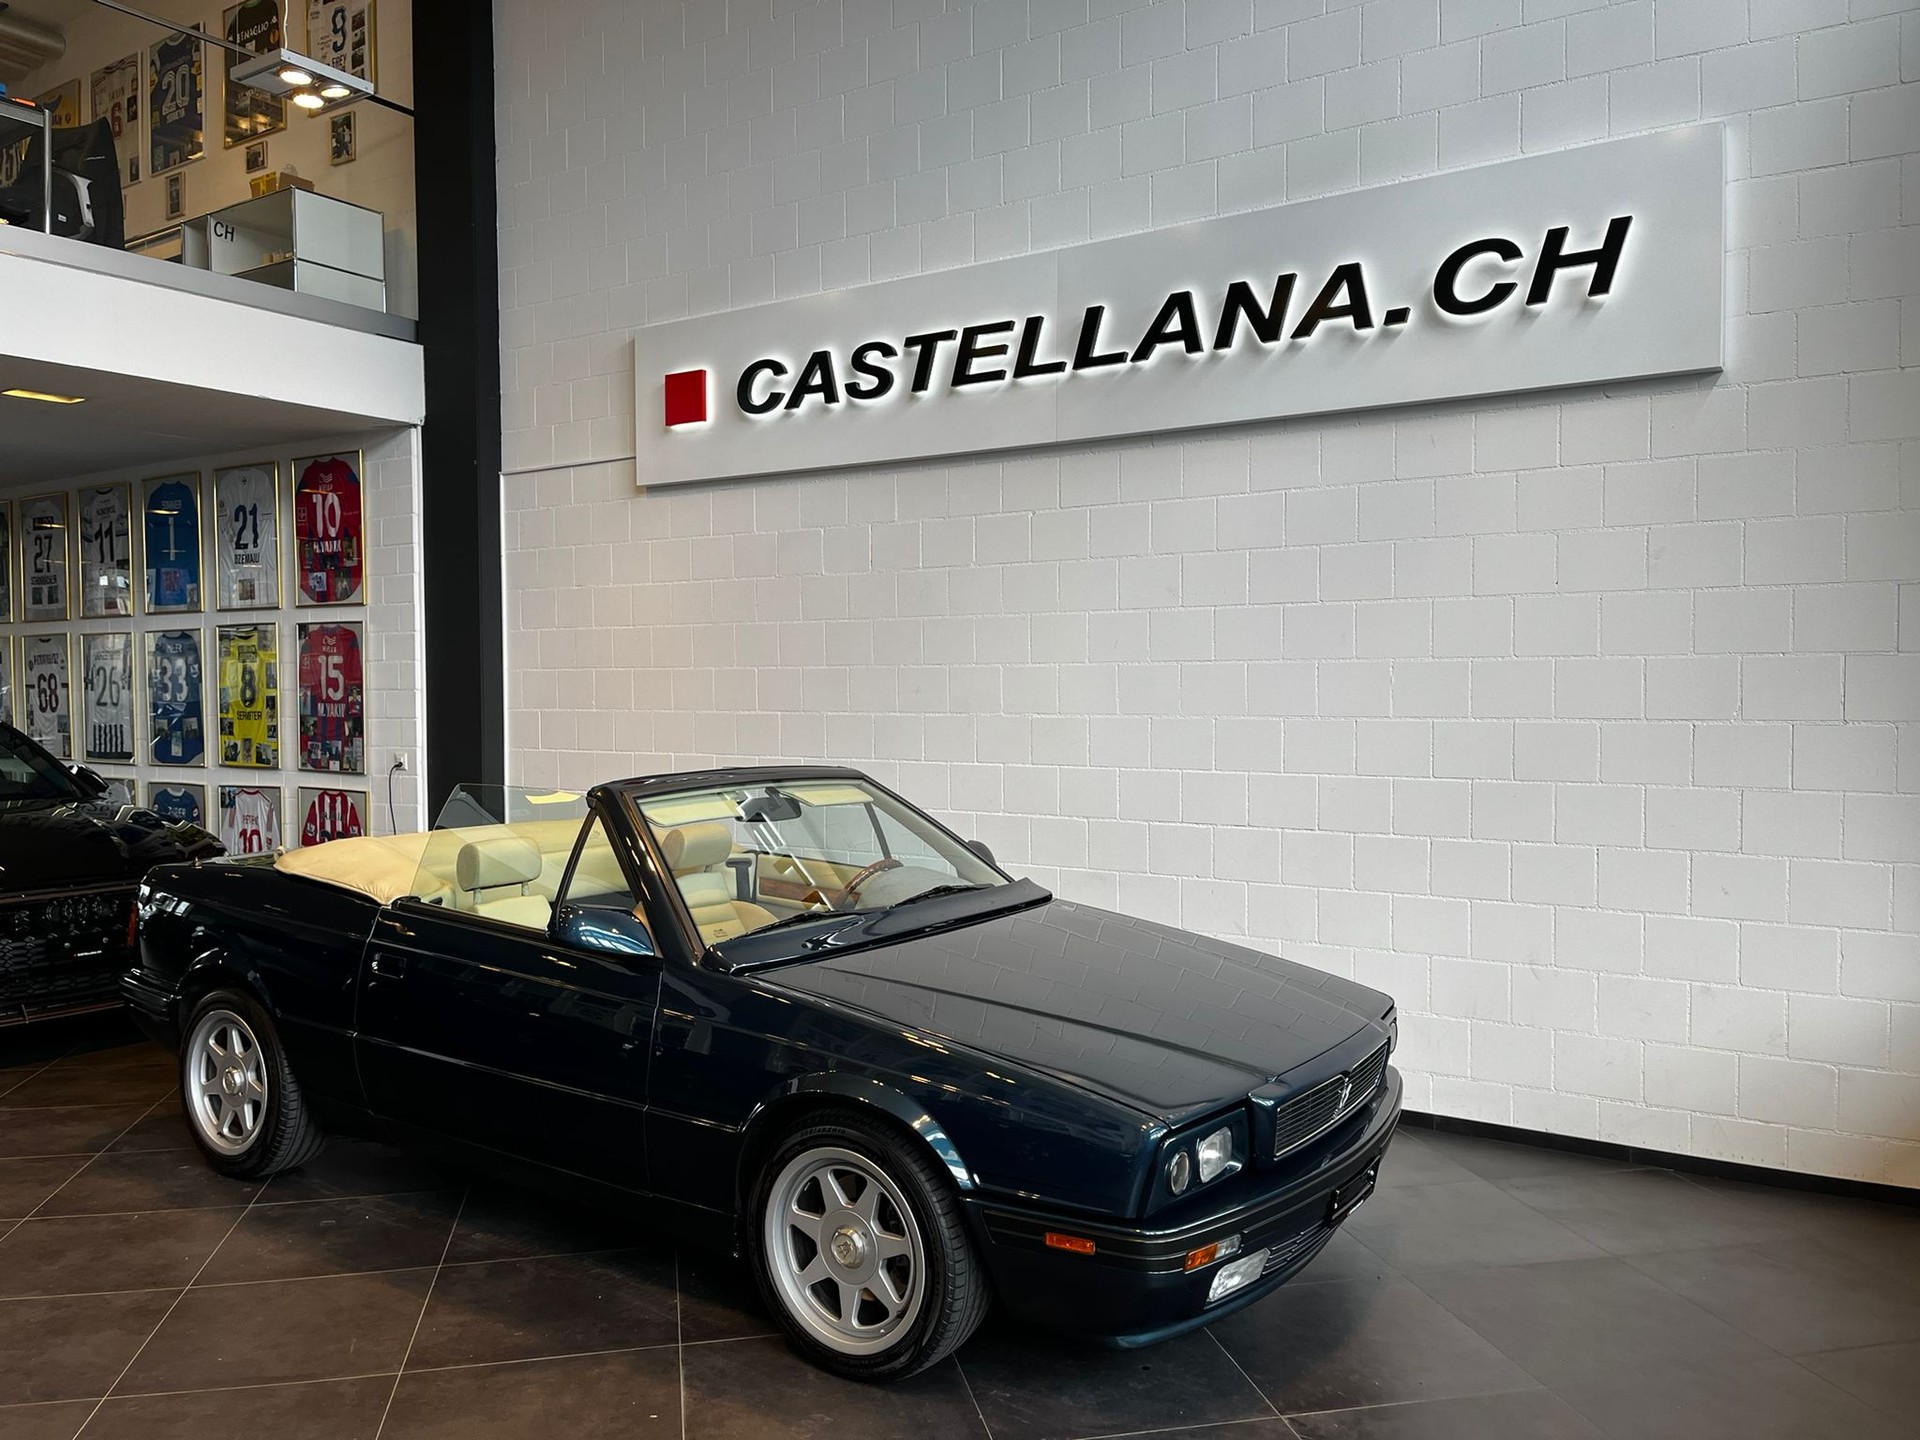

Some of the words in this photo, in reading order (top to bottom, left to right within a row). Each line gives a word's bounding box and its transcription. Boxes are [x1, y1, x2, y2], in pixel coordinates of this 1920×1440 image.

[162, 63, 190, 116] 20
[214, 221, 234, 242] CH
[737, 216, 1632, 414] CASTELLANA.CH
[234, 503, 259, 550] 21
[312, 492, 341, 538] 10
[34, 534, 53, 573] 27
[95, 521, 114, 563] 11
[38, 672, 59, 713] 68
[97, 666, 120, 707] 26
[160, 658, 188, 702] 33
[240, 664, 256, 708] 8
[318, 655, 343, 700] 15
